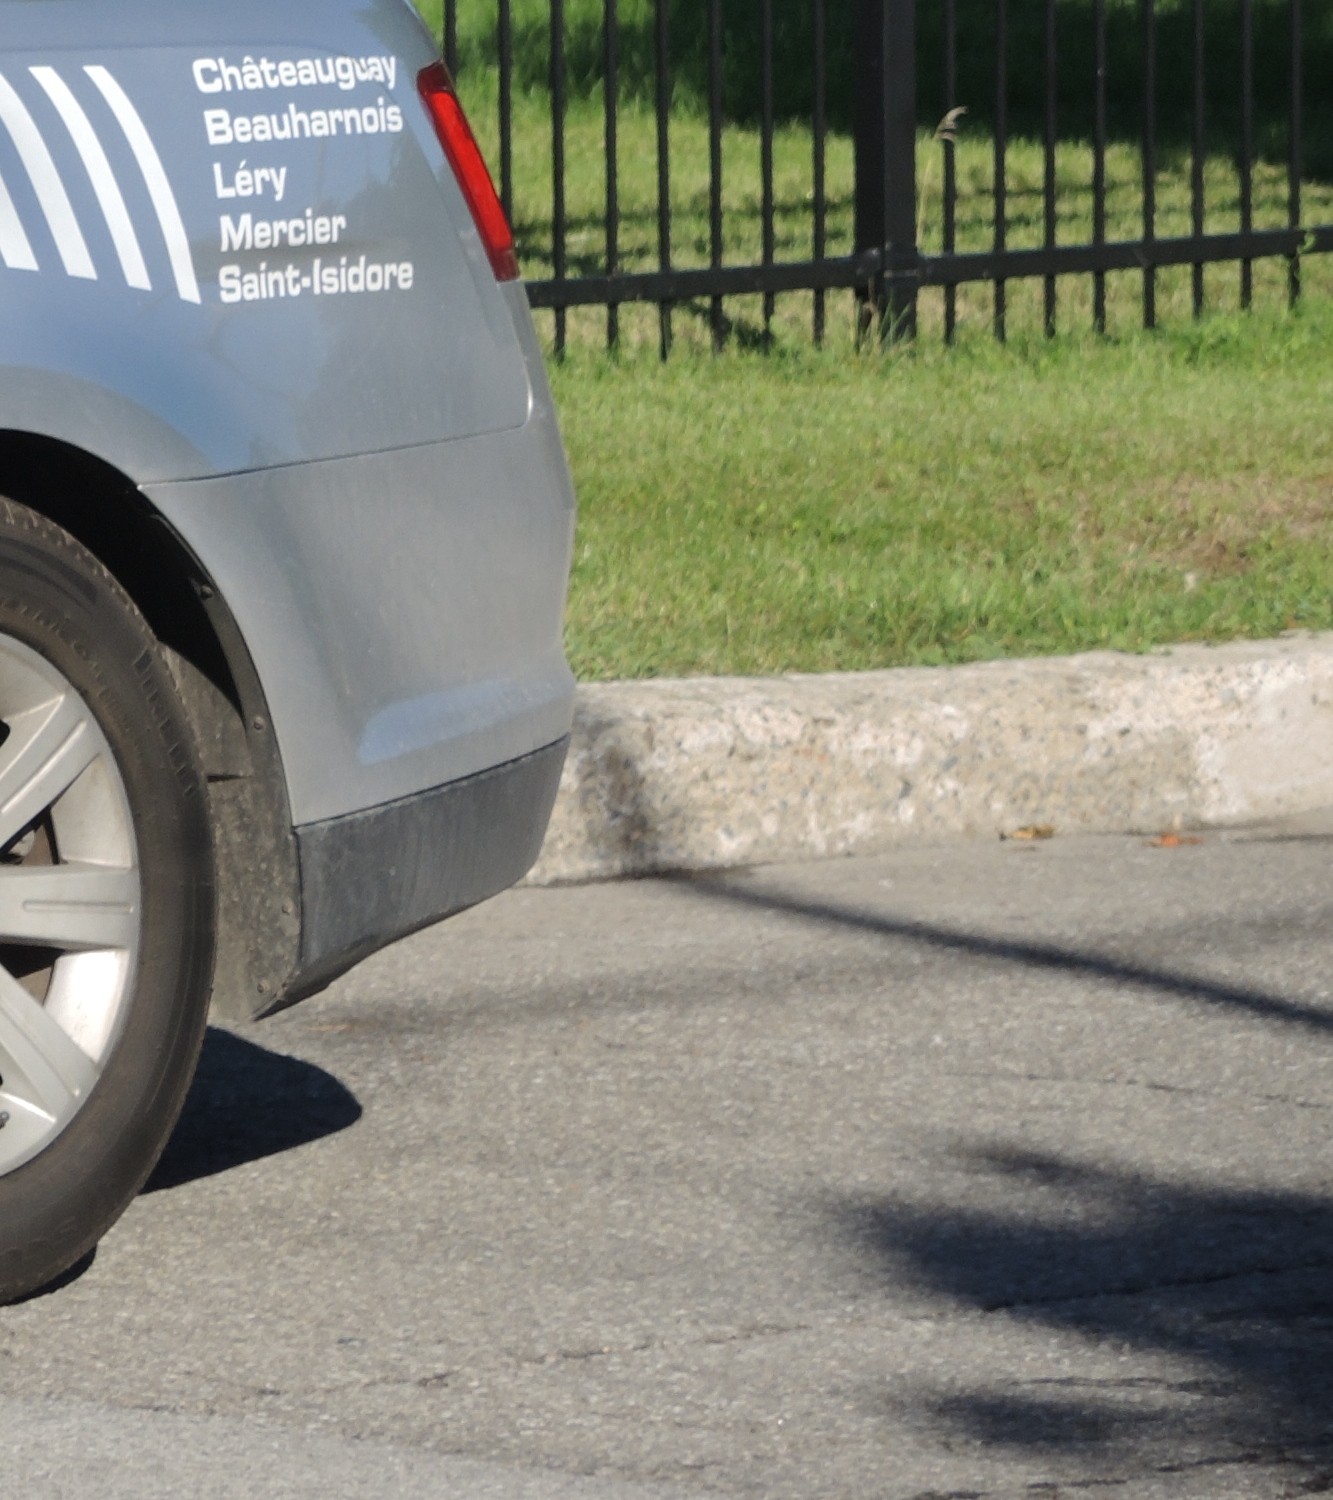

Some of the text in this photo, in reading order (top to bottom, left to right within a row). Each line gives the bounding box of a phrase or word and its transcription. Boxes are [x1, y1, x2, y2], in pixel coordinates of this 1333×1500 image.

[192, 55, 397, 94] Châteauguay
[204, 97, 404, 145] Beauharnois
[213, 160, 287, 201] Léry
[220, 208, 347, 252] Mercier
[218, 255, 414, 303] Saint-Isidore
